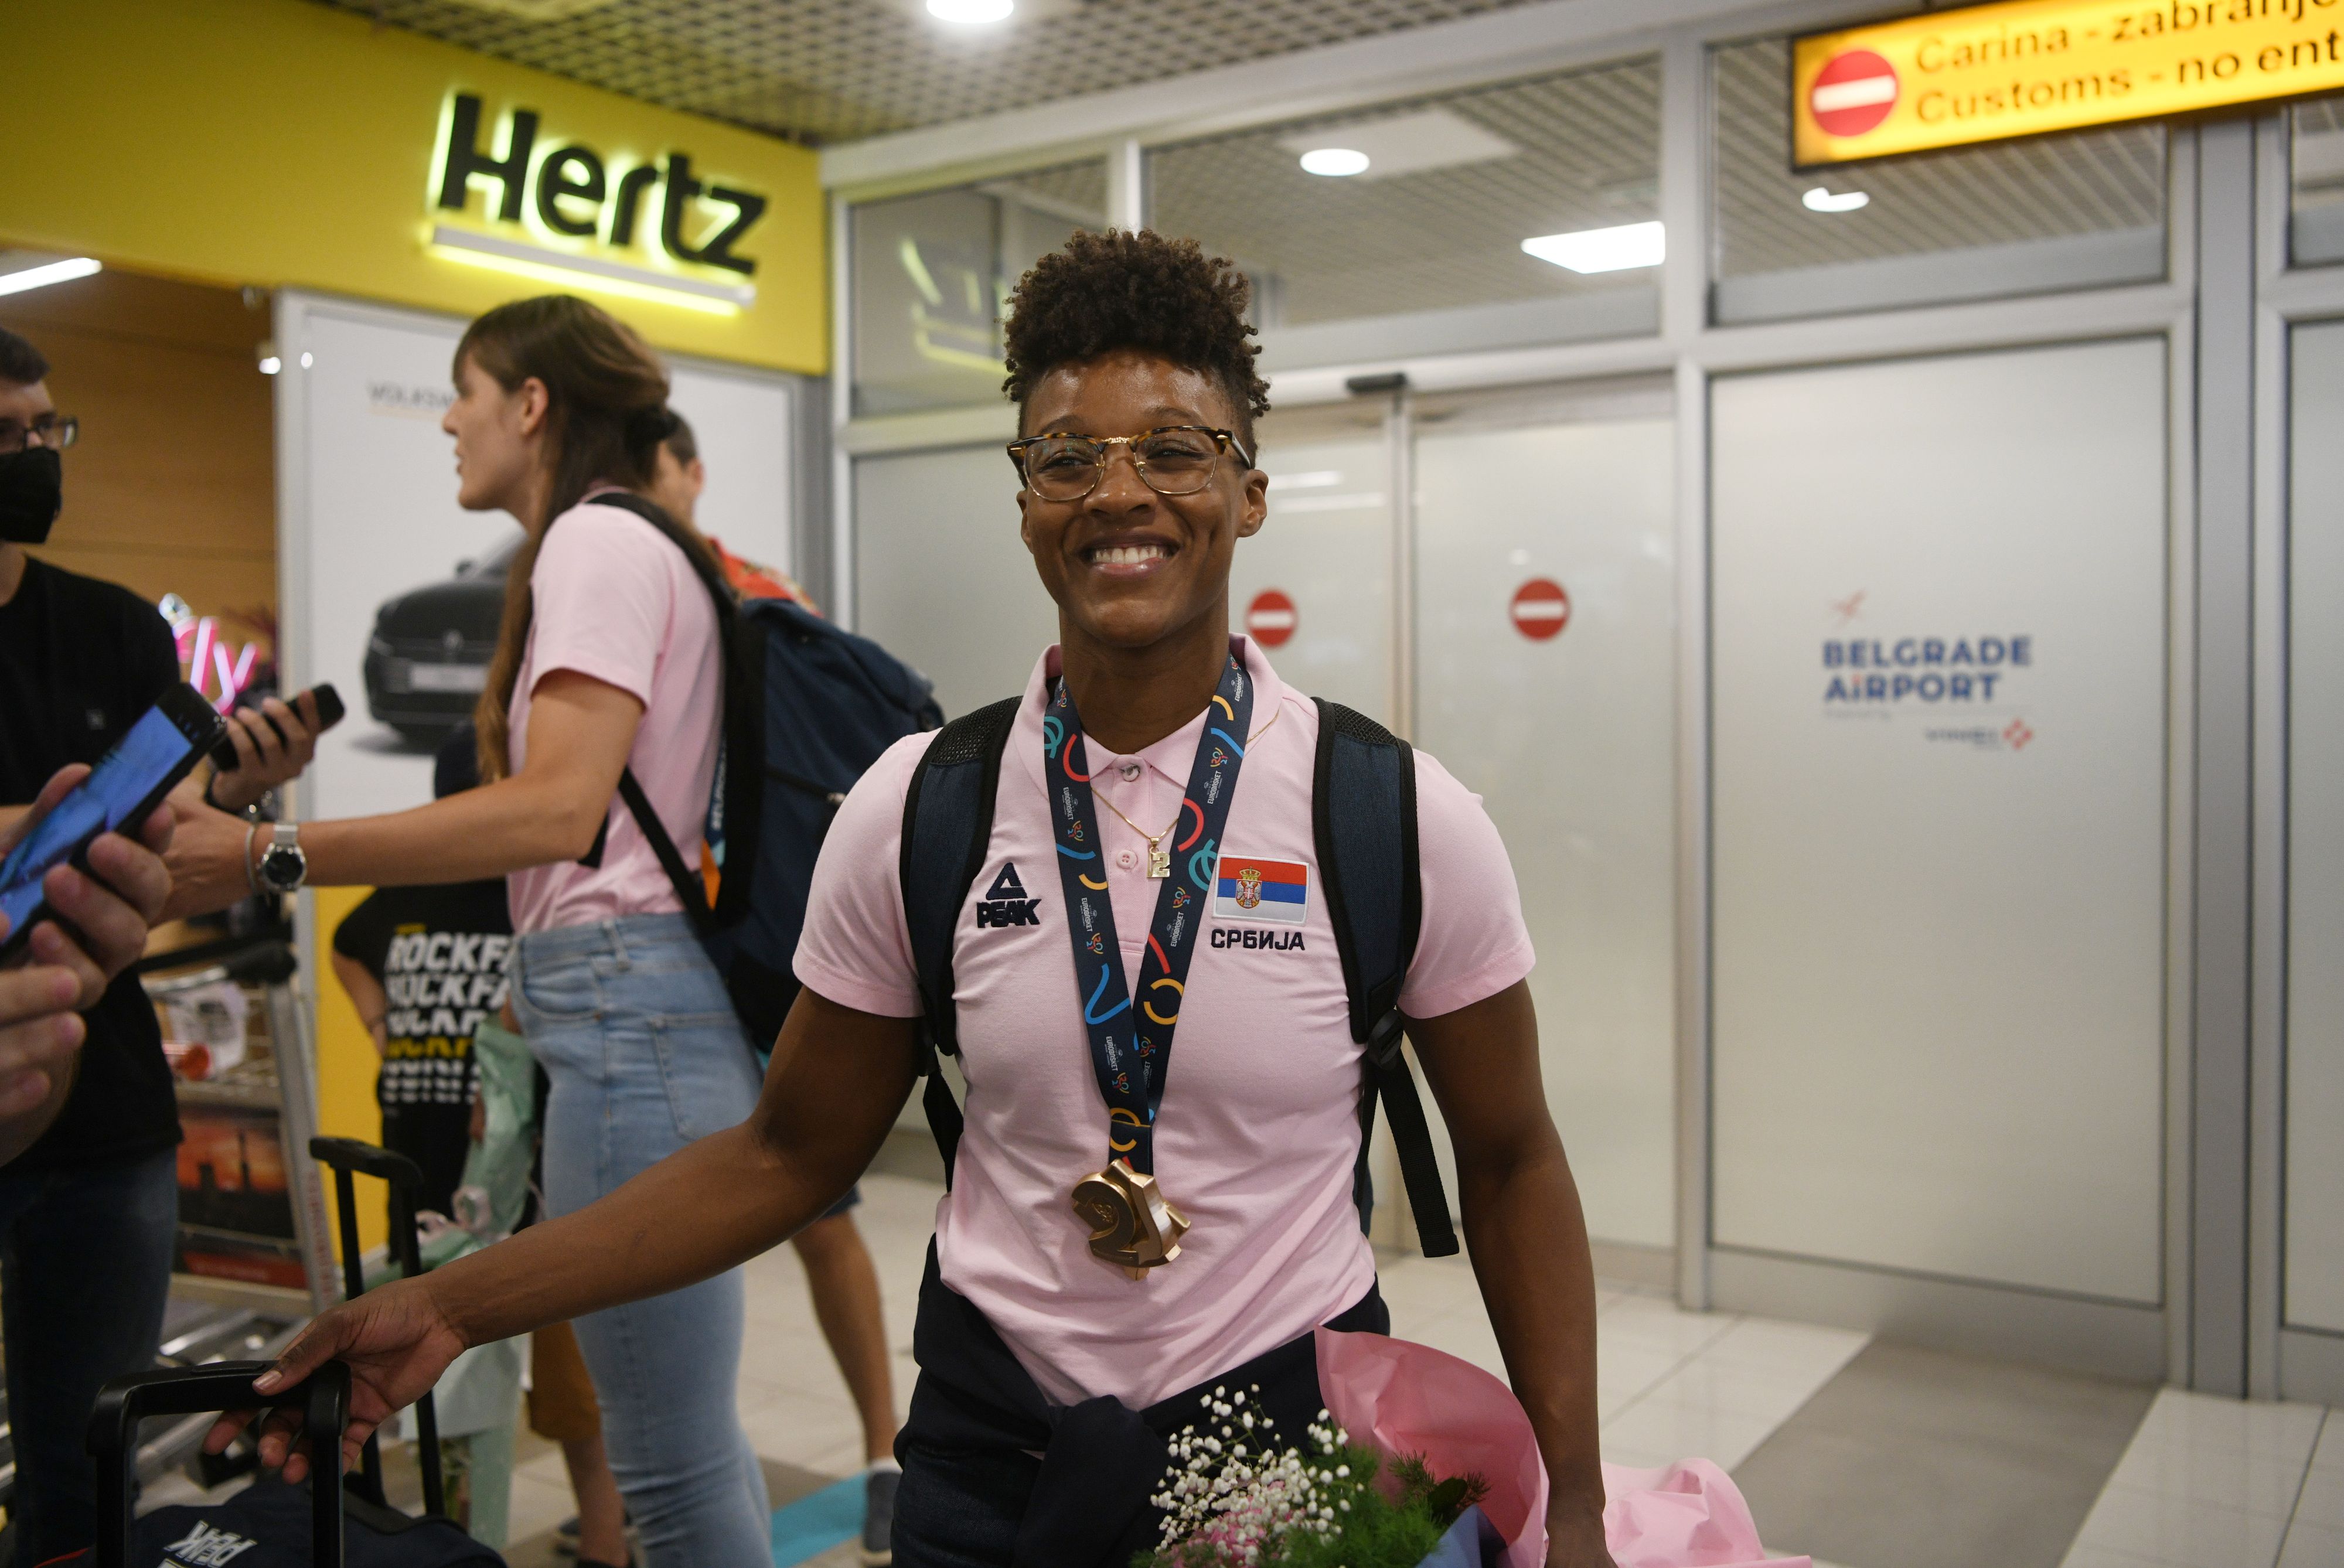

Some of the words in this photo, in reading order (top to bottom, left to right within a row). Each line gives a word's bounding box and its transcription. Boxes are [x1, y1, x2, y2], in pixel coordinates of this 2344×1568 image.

[1916, 26, 2069, 74] Carina
[1916, 68, 2131, 123] Customs
[2178, 53, 2241, 83] no
[437, 92, 768, 275] Hertz
[1823, 634, 2032, 668] BELGRADE
[1063, 786, 1074, 820] EUROBASKET
[1207, 770, 1222, 805] EUROBASKET
[976, 898, 1042, 929] PEAK
[1081, 897, 1093, 932] EUROBASKET
[1170, 911, 1184, 947] EUROBASKET
[1211, 929, 1306, 951] СРБИЈА
[1106, 1035, 1118, 1071] EUROBASKET
